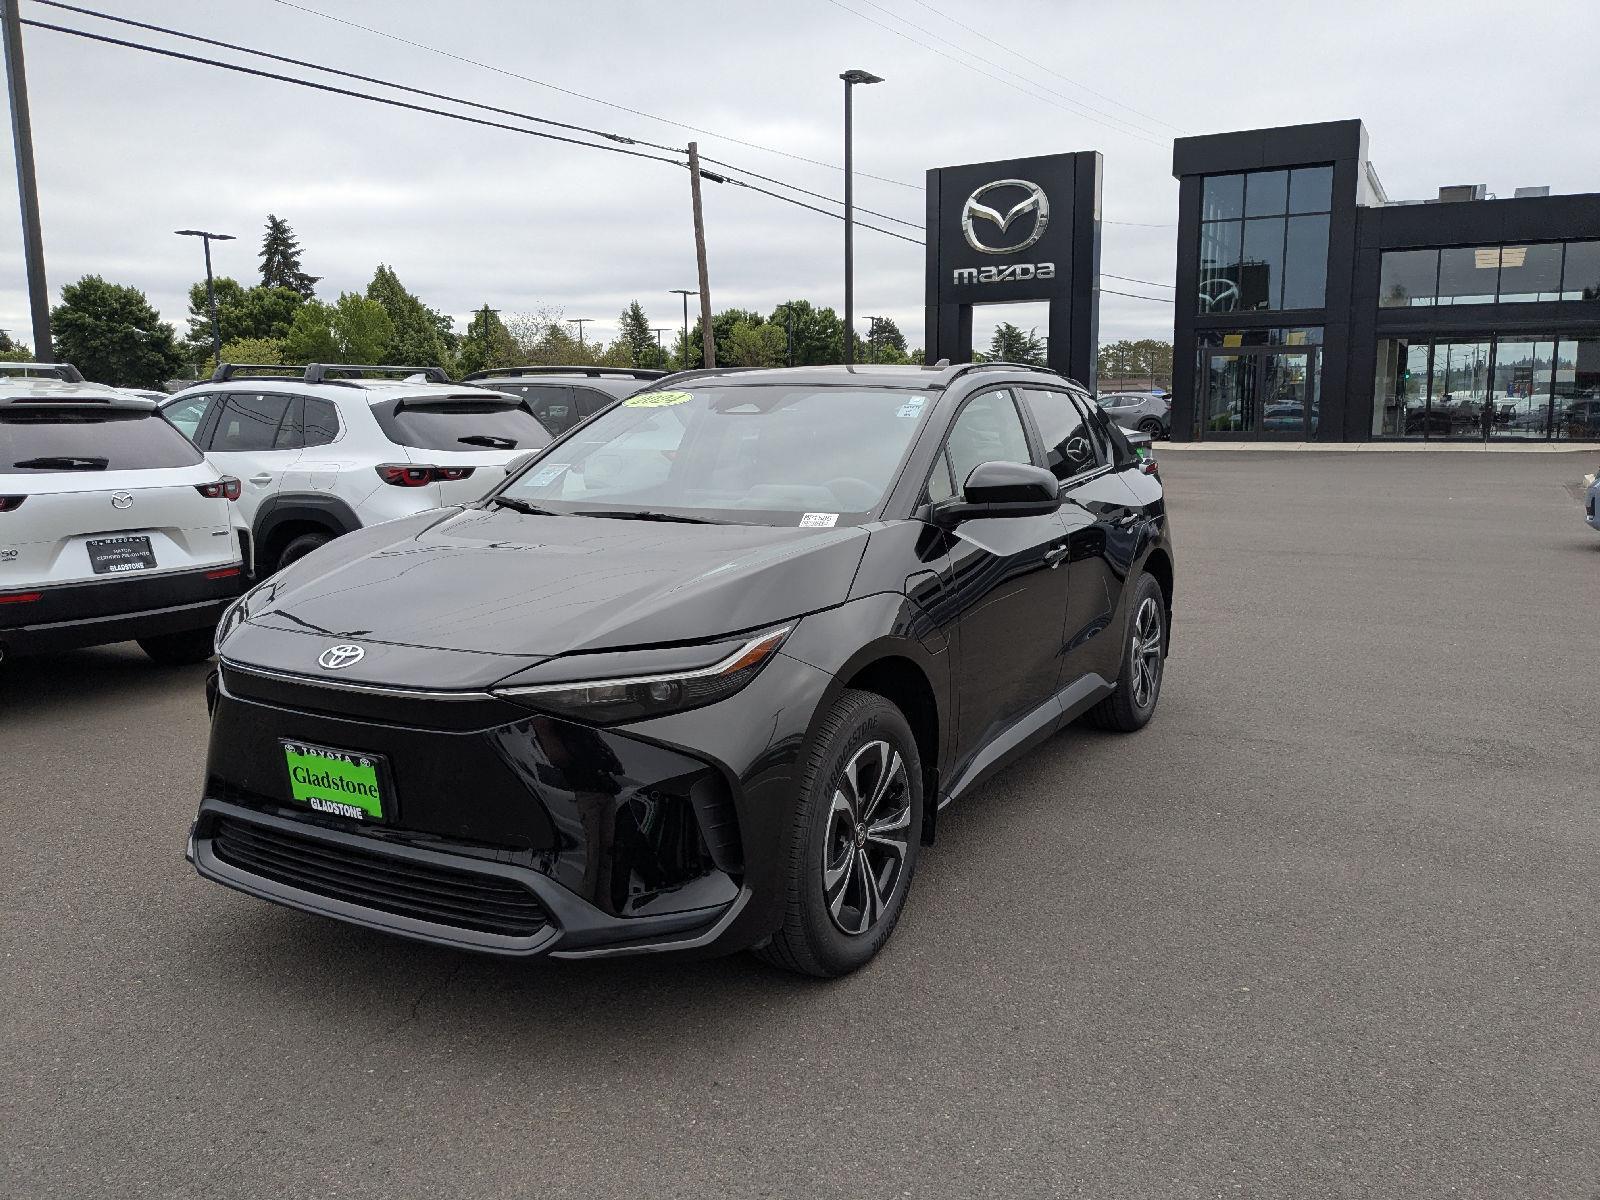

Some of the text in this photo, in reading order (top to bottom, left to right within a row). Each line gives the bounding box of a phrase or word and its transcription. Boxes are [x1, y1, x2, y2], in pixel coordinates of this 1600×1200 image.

[953, 262, 1056, 285] mazda
[109, 561, 145, 572] GLADSTONE
[301, 746, 352, 763] TOYOTA
[292, 765, 378, 799] Gladstone
[310, 797, 364, 820] GLADSTONE
